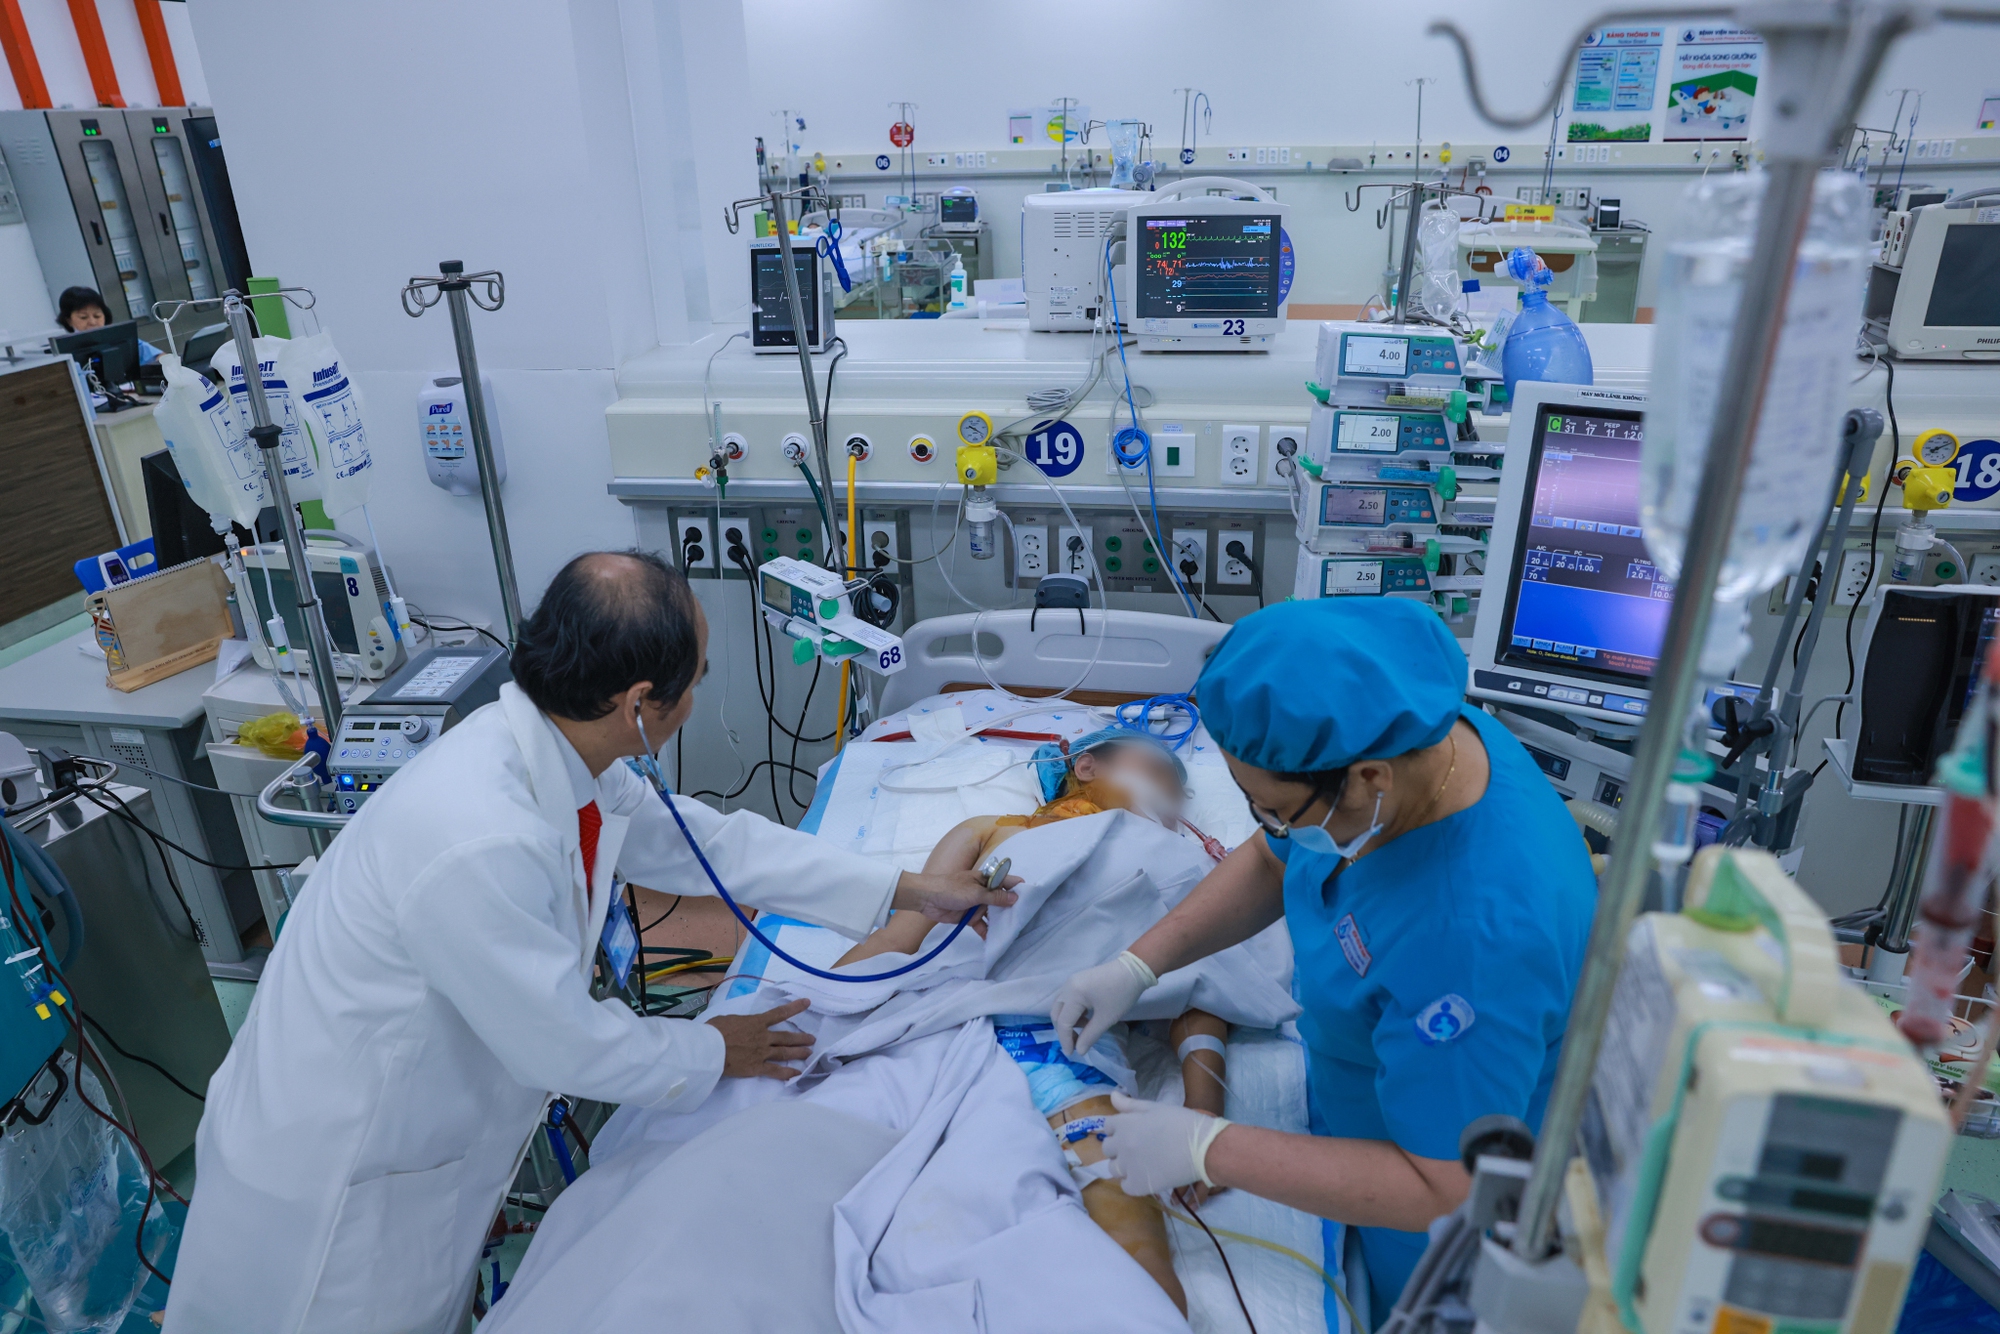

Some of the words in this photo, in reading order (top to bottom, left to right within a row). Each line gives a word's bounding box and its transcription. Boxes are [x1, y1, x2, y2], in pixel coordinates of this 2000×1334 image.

[1495, 149, 1508, 159] 04
[878, 158, 889, 167] 06
[1162, 232, 1186, 248] 132
[1223, 319, 1245, 335] 23
[1379, 349, 1400, 360] 4.00
[1550, 418, 1560, 431] C
[1371, 427, 1391, 437] 2.00
[1565, 425, 1575, 433] 31
[1606, 429, 1615, 437] 11
[1036, 432, 1077, 465] 19
[1956, 453, 2000, 489] 18
[1358, 500, 1378, 509] 2.50
[1357, 572, 1375, 580] 2.50
[346, 577, 359, 596] 8
[880, 646, 901, 669] 68
[998, 1029, 1028, 1037] Caryn
